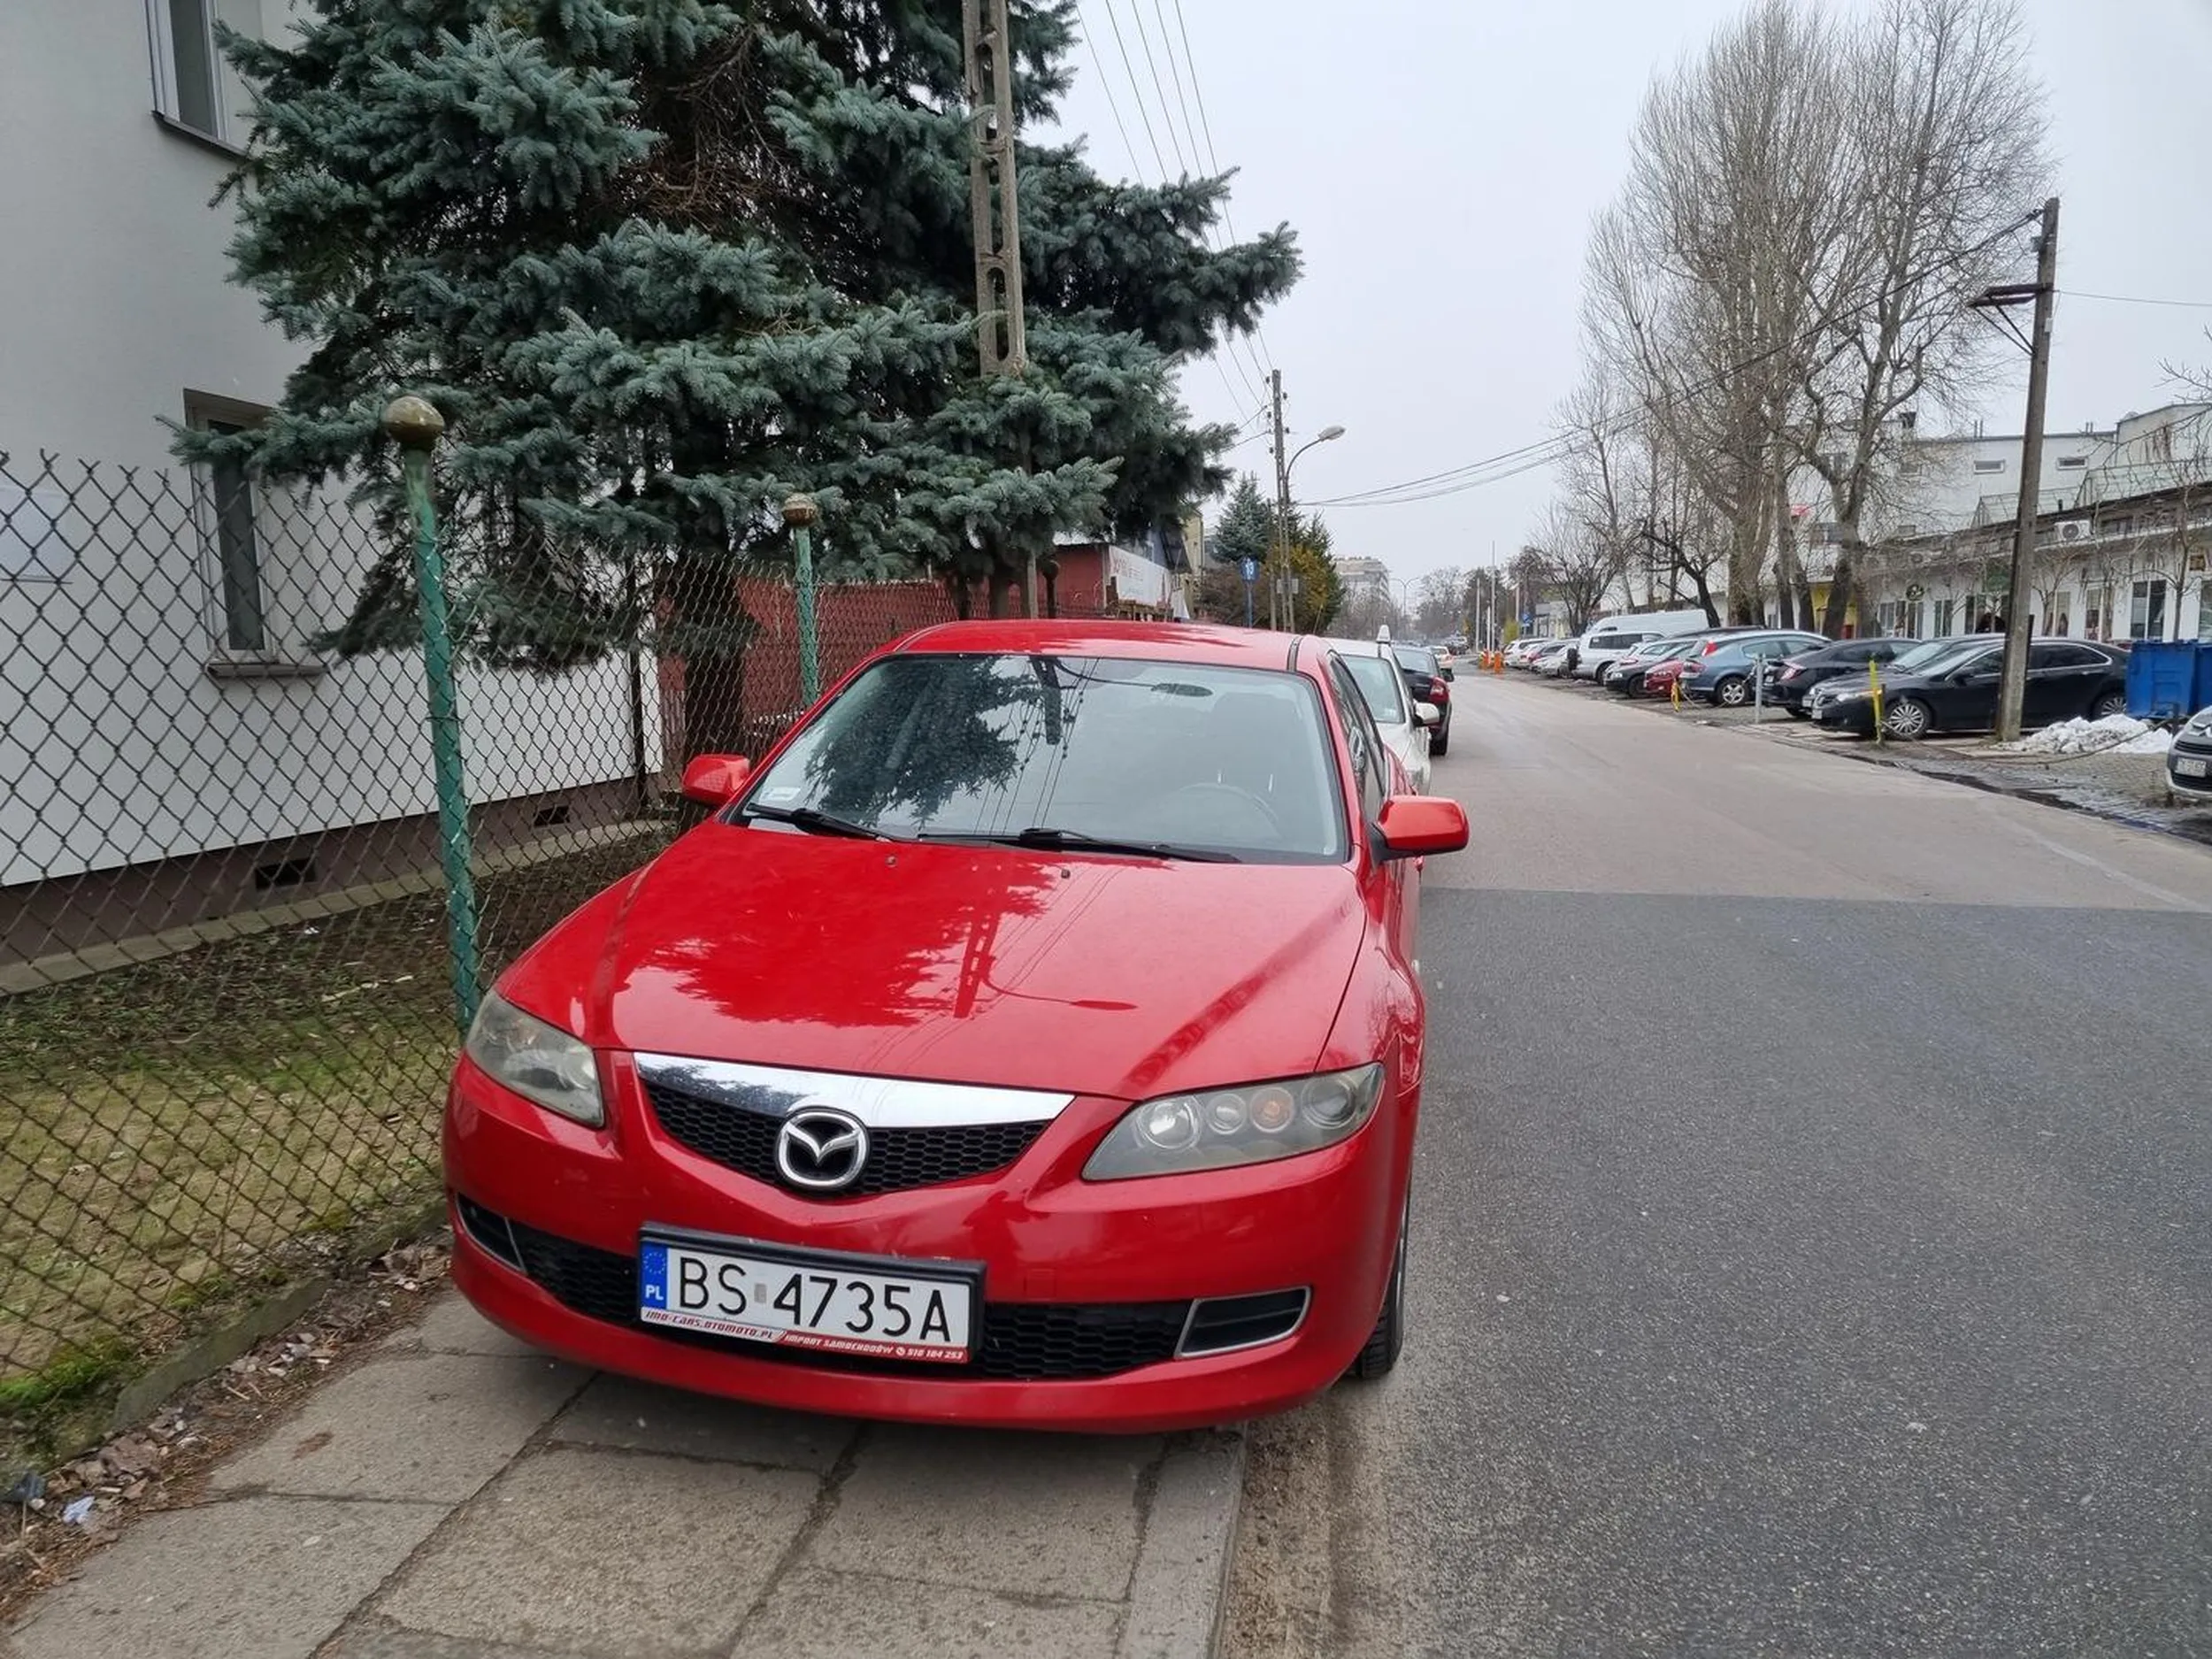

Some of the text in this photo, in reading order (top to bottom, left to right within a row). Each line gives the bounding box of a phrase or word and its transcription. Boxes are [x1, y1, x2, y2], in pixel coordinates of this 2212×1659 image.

[645, 1285, 664, 1301] PL
[680, 1257, 951, 1342] BS 4735A
[784, 1333, 821, 1347] IMPORT
